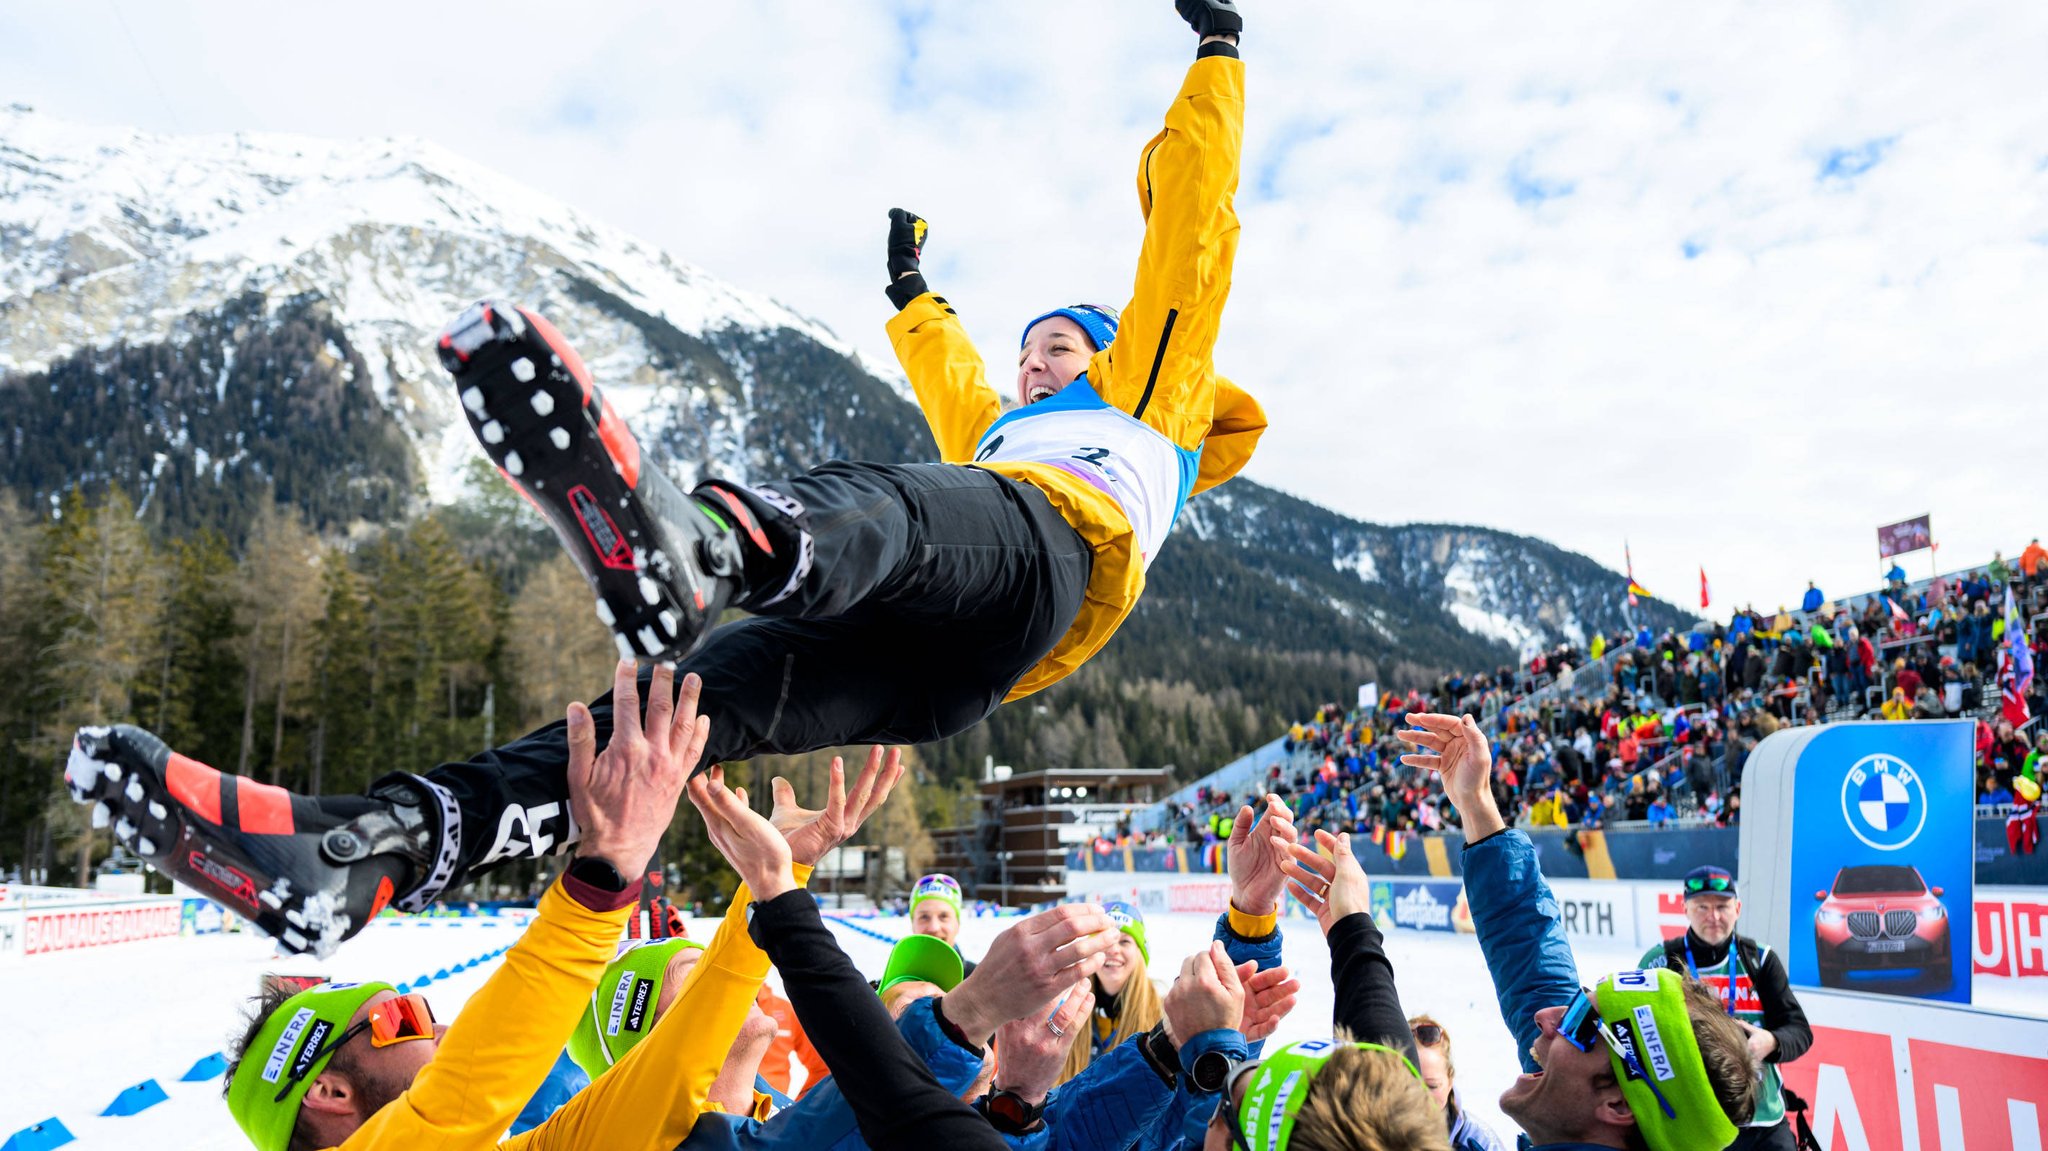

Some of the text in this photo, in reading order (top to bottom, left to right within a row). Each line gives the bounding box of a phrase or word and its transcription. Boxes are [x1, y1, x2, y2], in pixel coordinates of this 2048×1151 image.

[1850, 758, 1913, 788] BMW
[1562, 901, 1614, 936] RTH
[632, 980, 650, 1017] TERREX
[299, 1022, 328, 1066] TERREX
